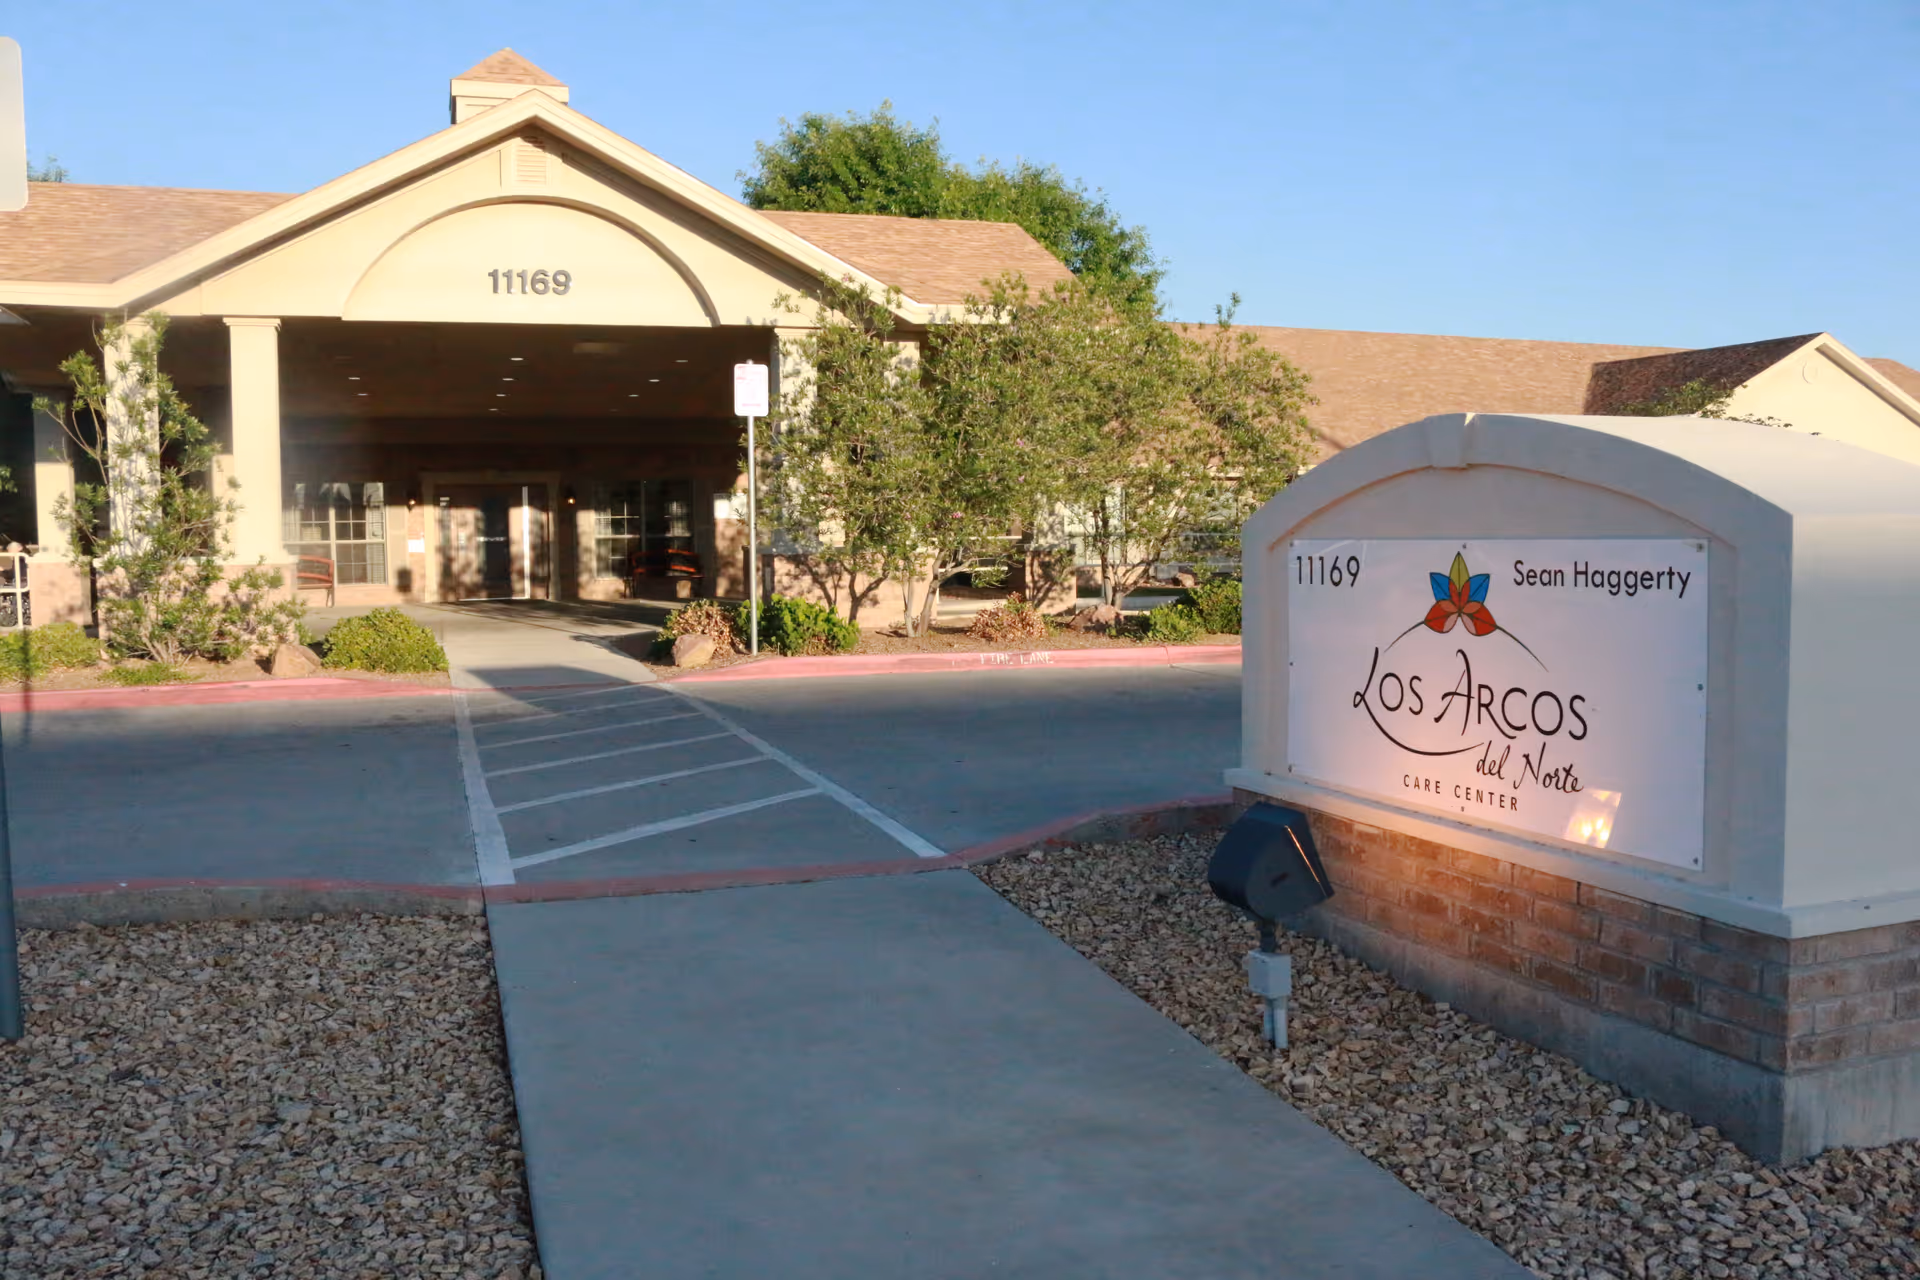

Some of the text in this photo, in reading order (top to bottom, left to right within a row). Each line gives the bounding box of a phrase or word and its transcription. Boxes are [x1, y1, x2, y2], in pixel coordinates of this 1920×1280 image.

[488, 269, 572, 295] 11169
[1297, 555, 1360, 587] 11169
[1513, 559, 1691, 599] Sean Haggerty
[1020, 652, 1054, 664] LANE
[1433, 649, 1588, 741] ARCOS
[1476, 740, 1585, 794] del Norte
[1403, 774, 1518, 812] CARE CENTER
